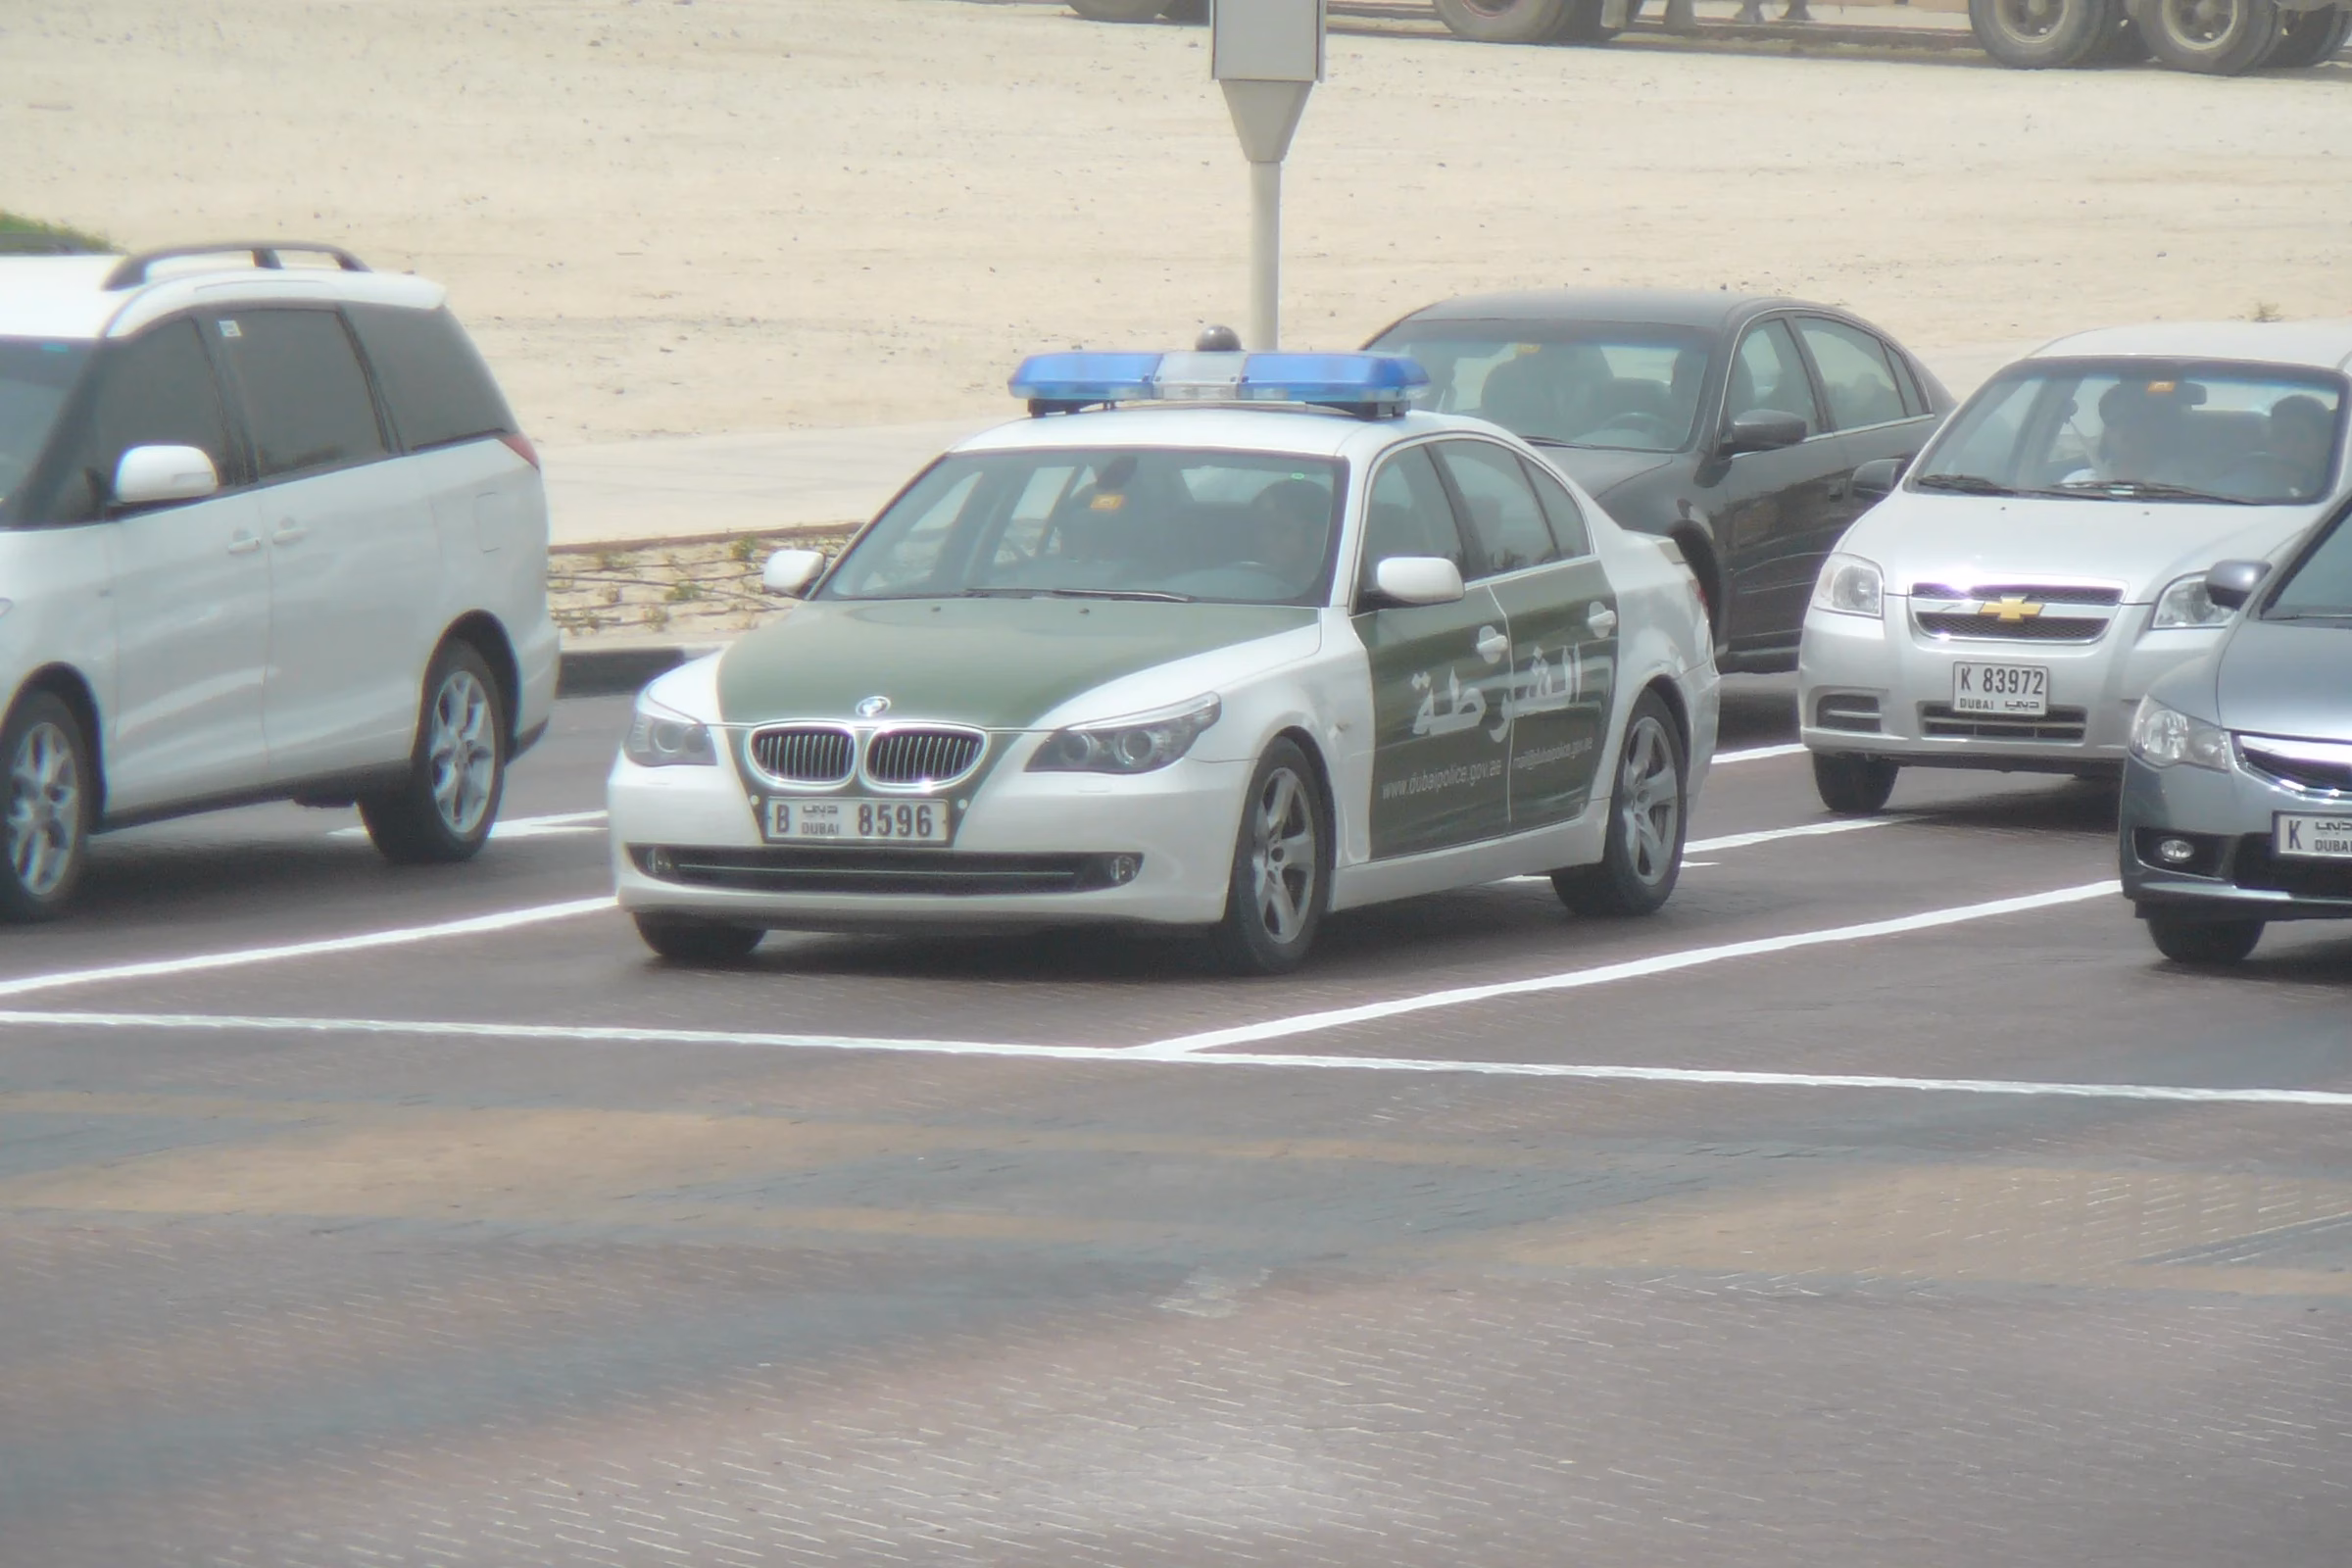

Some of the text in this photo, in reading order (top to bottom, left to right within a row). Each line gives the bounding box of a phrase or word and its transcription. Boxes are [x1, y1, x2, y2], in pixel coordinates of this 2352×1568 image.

[1411, 641, 1583, 743] الشرطة
[1961, 666, 2044, 695] K 83972
[1959, 697, 1994, 710] DUBAI
[775, 803, 932, 837] B 8596
[801, 821, 840, 835] DUBAI
[2288, 819, 2303, 850] K
